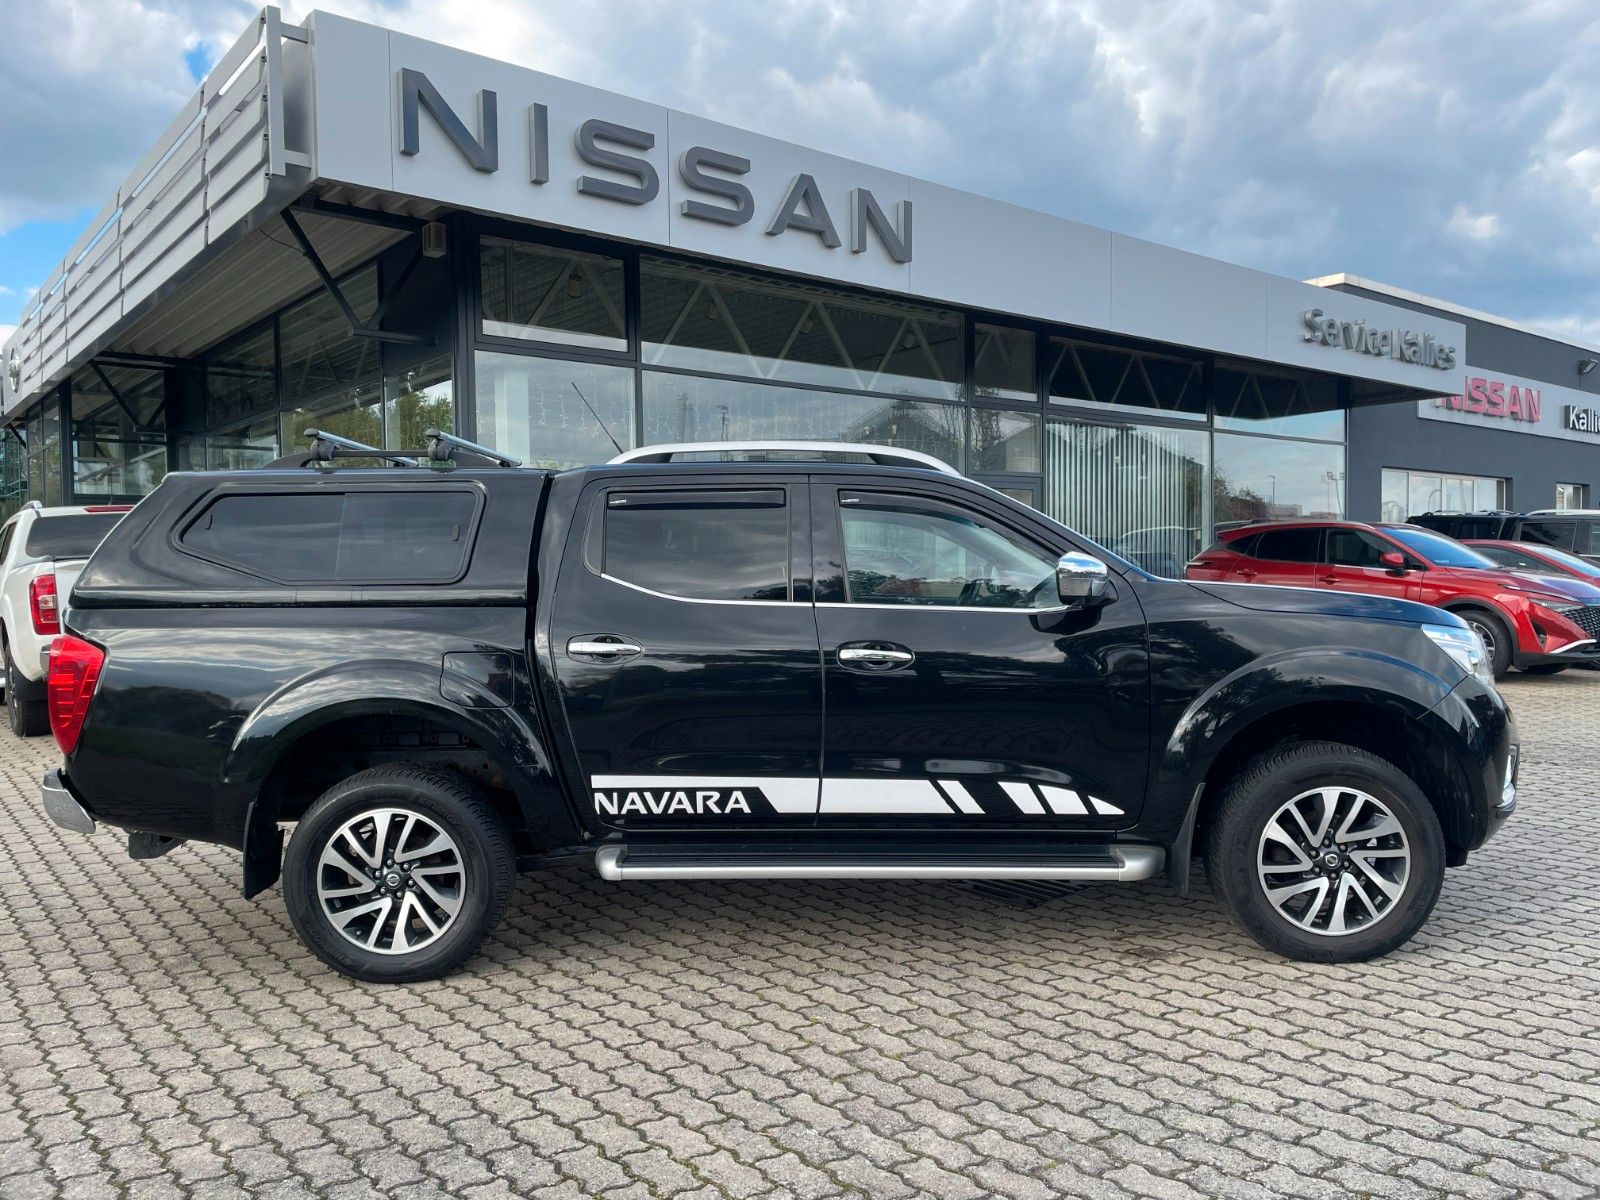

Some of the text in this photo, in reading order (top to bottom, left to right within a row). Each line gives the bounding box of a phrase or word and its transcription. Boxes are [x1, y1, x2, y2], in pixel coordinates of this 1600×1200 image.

[399, 67, 913, 264] NISSAN
[1565, 405, 1600, 433] Kalli
[594, 790, 752, 815] NAVARA
